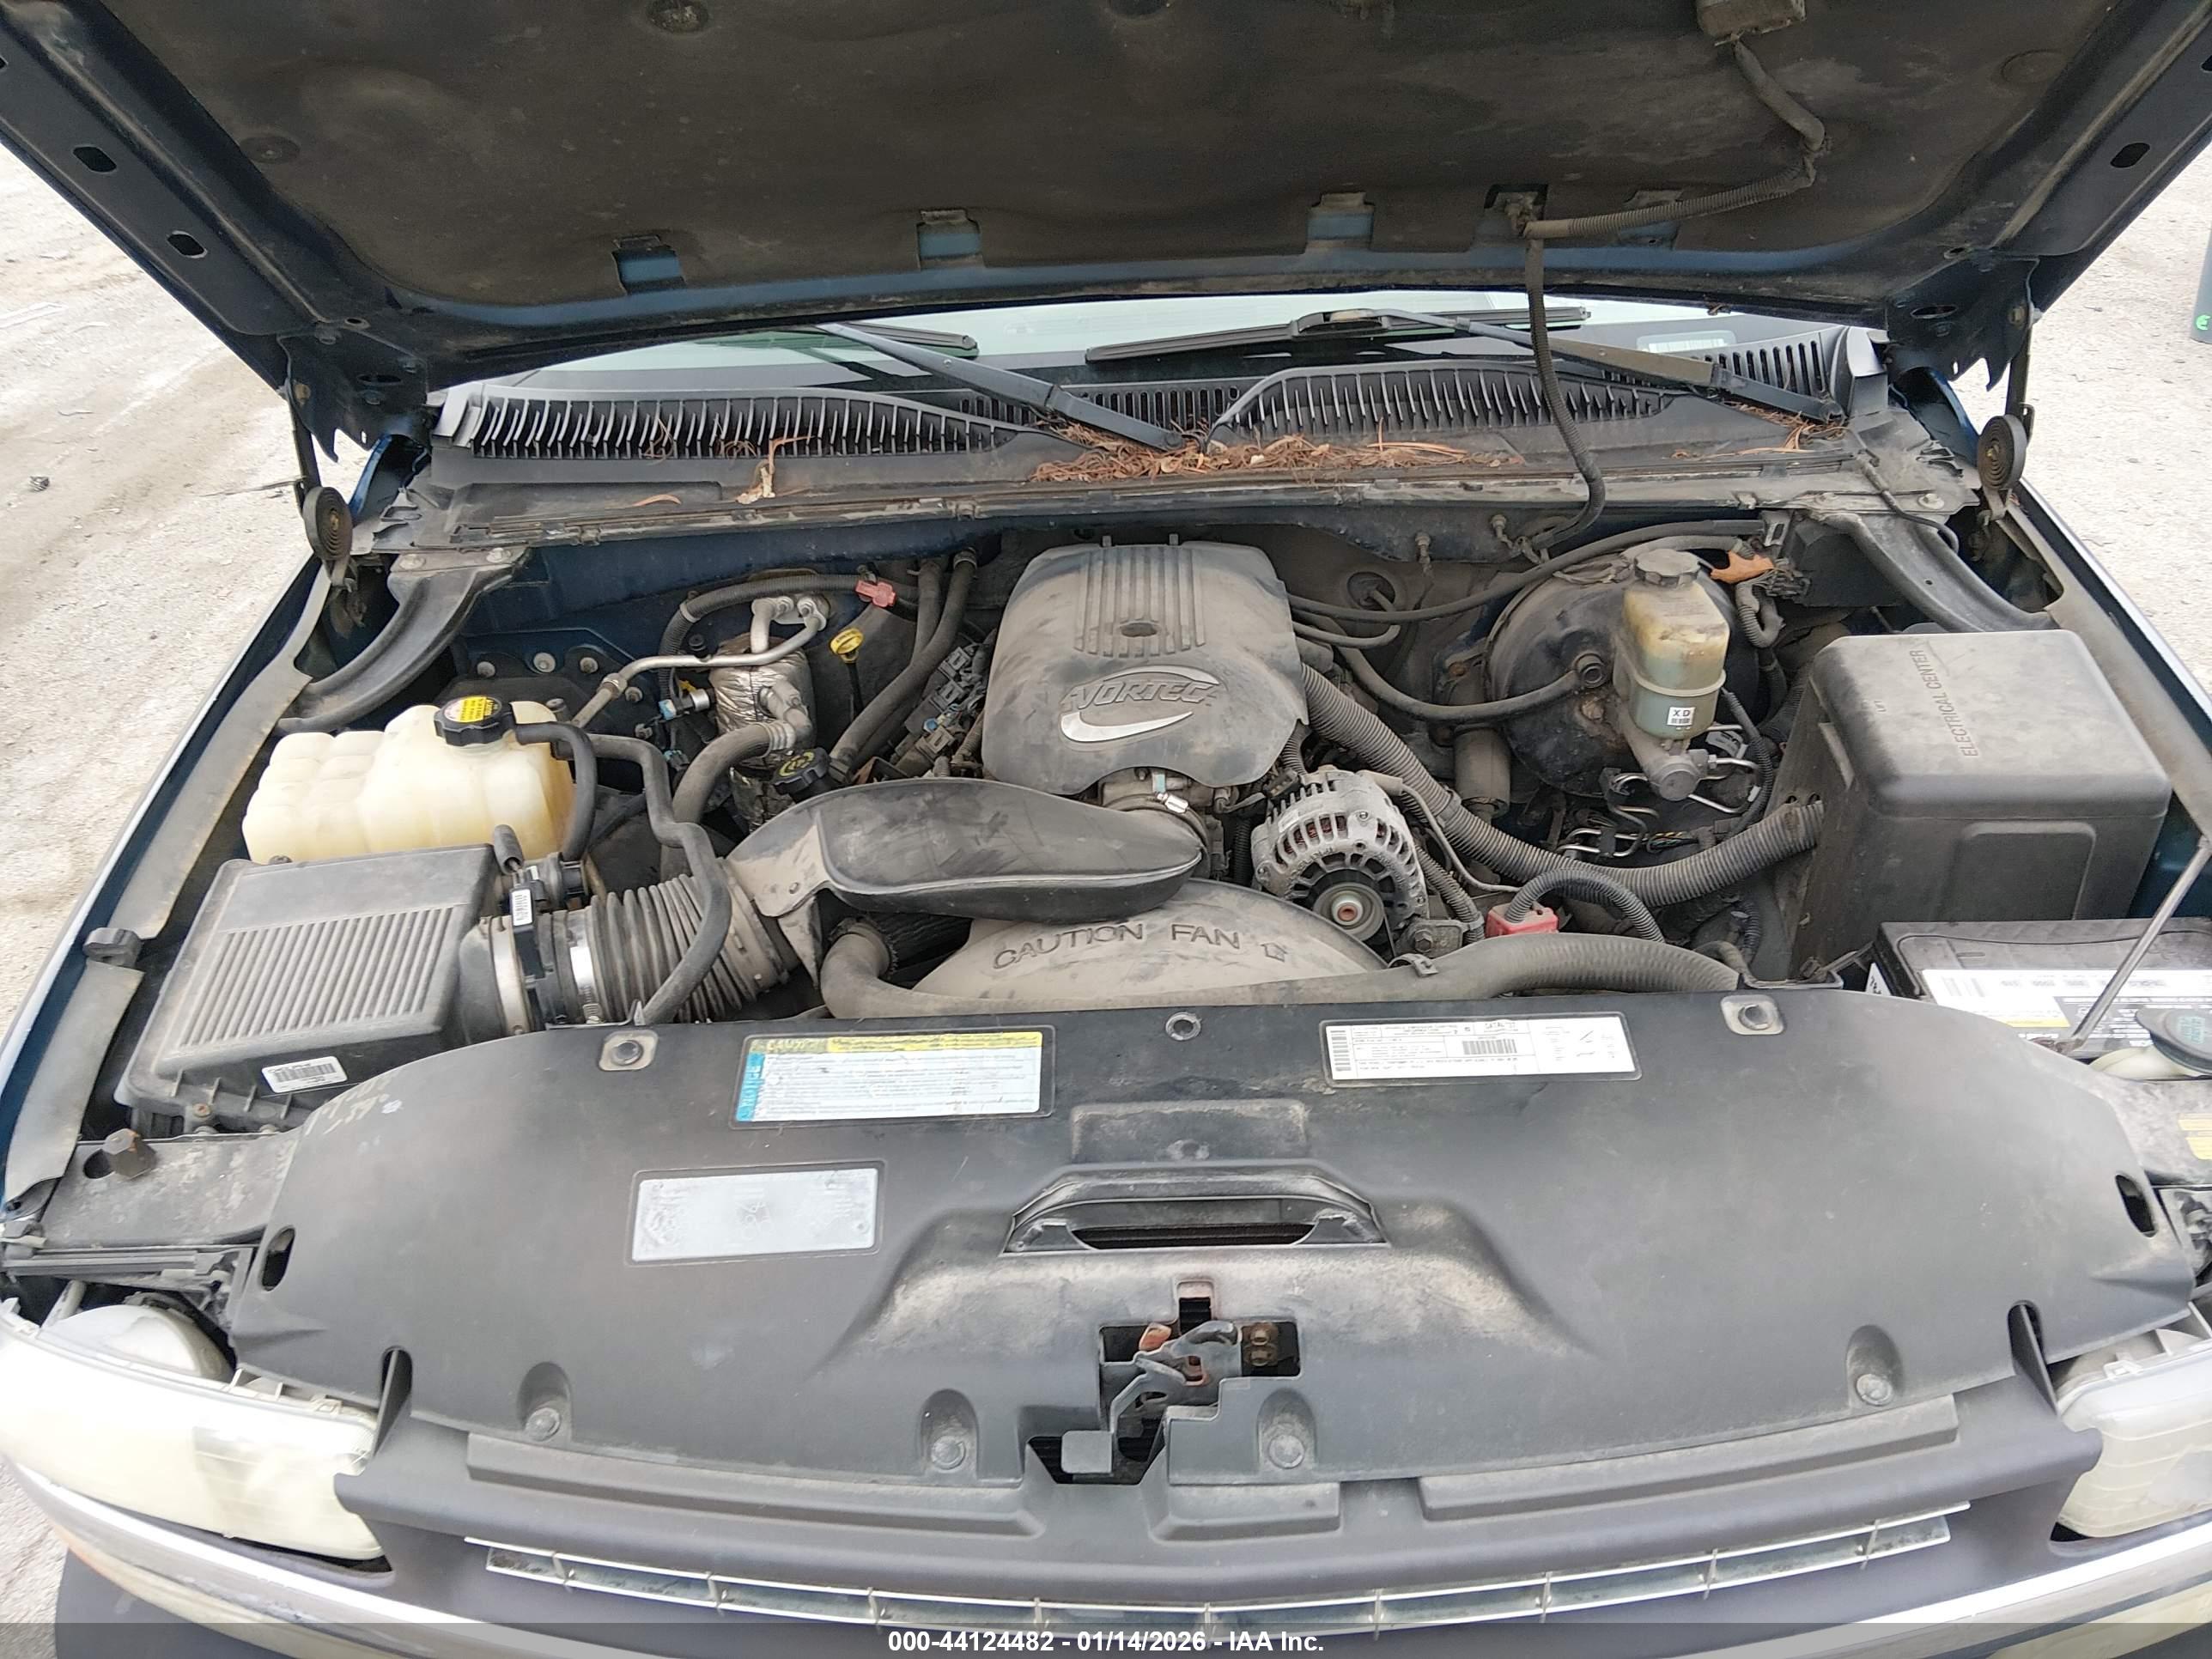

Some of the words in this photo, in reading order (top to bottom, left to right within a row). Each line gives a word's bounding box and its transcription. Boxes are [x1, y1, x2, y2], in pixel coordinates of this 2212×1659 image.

[1909, 649, 1943, 690] CENTER
[1076, 679, 1214, 710] VORTEC
[1931, 691, 1979, 757] ELECTRICAL
[992, 922, 1144, 970] CAUTION
[1170, 923, 1241, 950] FAN
